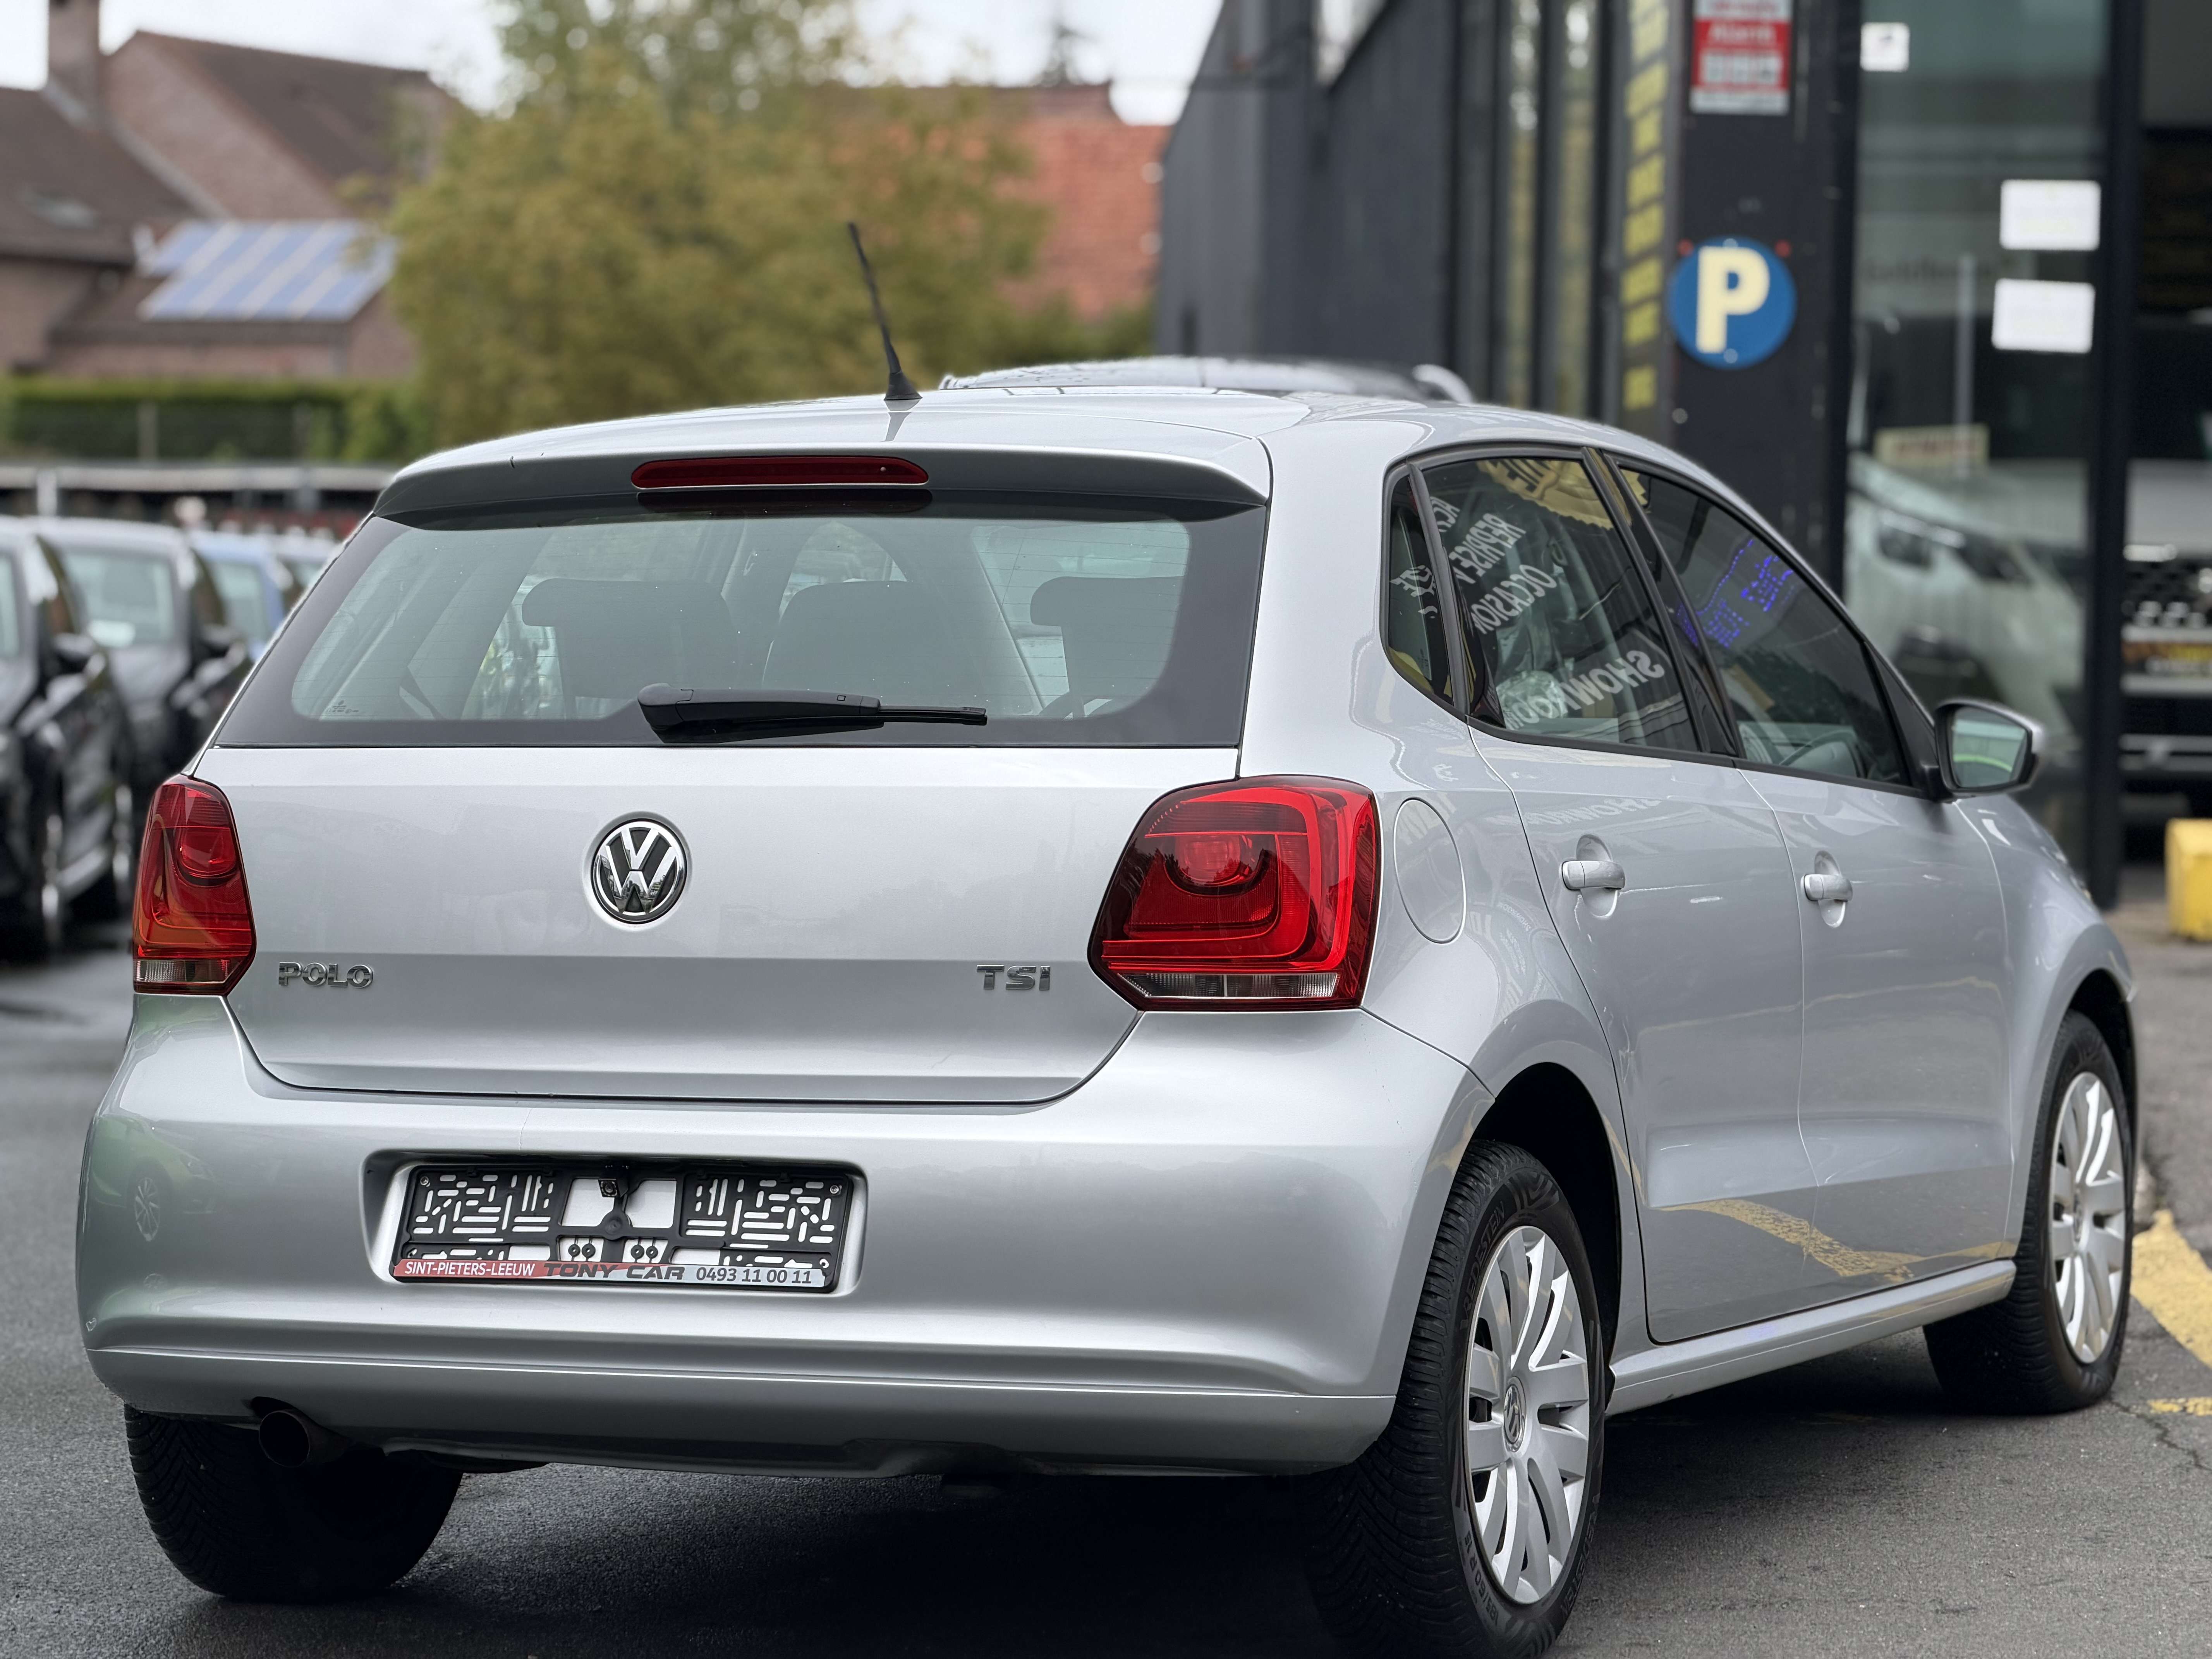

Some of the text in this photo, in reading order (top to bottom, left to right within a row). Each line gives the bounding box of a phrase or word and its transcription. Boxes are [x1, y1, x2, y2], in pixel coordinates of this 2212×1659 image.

[1695, 246, 1770, 354] P
[278, 962, 374, 988] POLO
[976, 965, 1051, 991] TSI
[404, 1261, 536, 1276] SINT-PIETERS-LEEUW
[544, 1263, 685, 1279] TONY CAR
[696, 1267, 811, 1284] 0493 11 00 11
